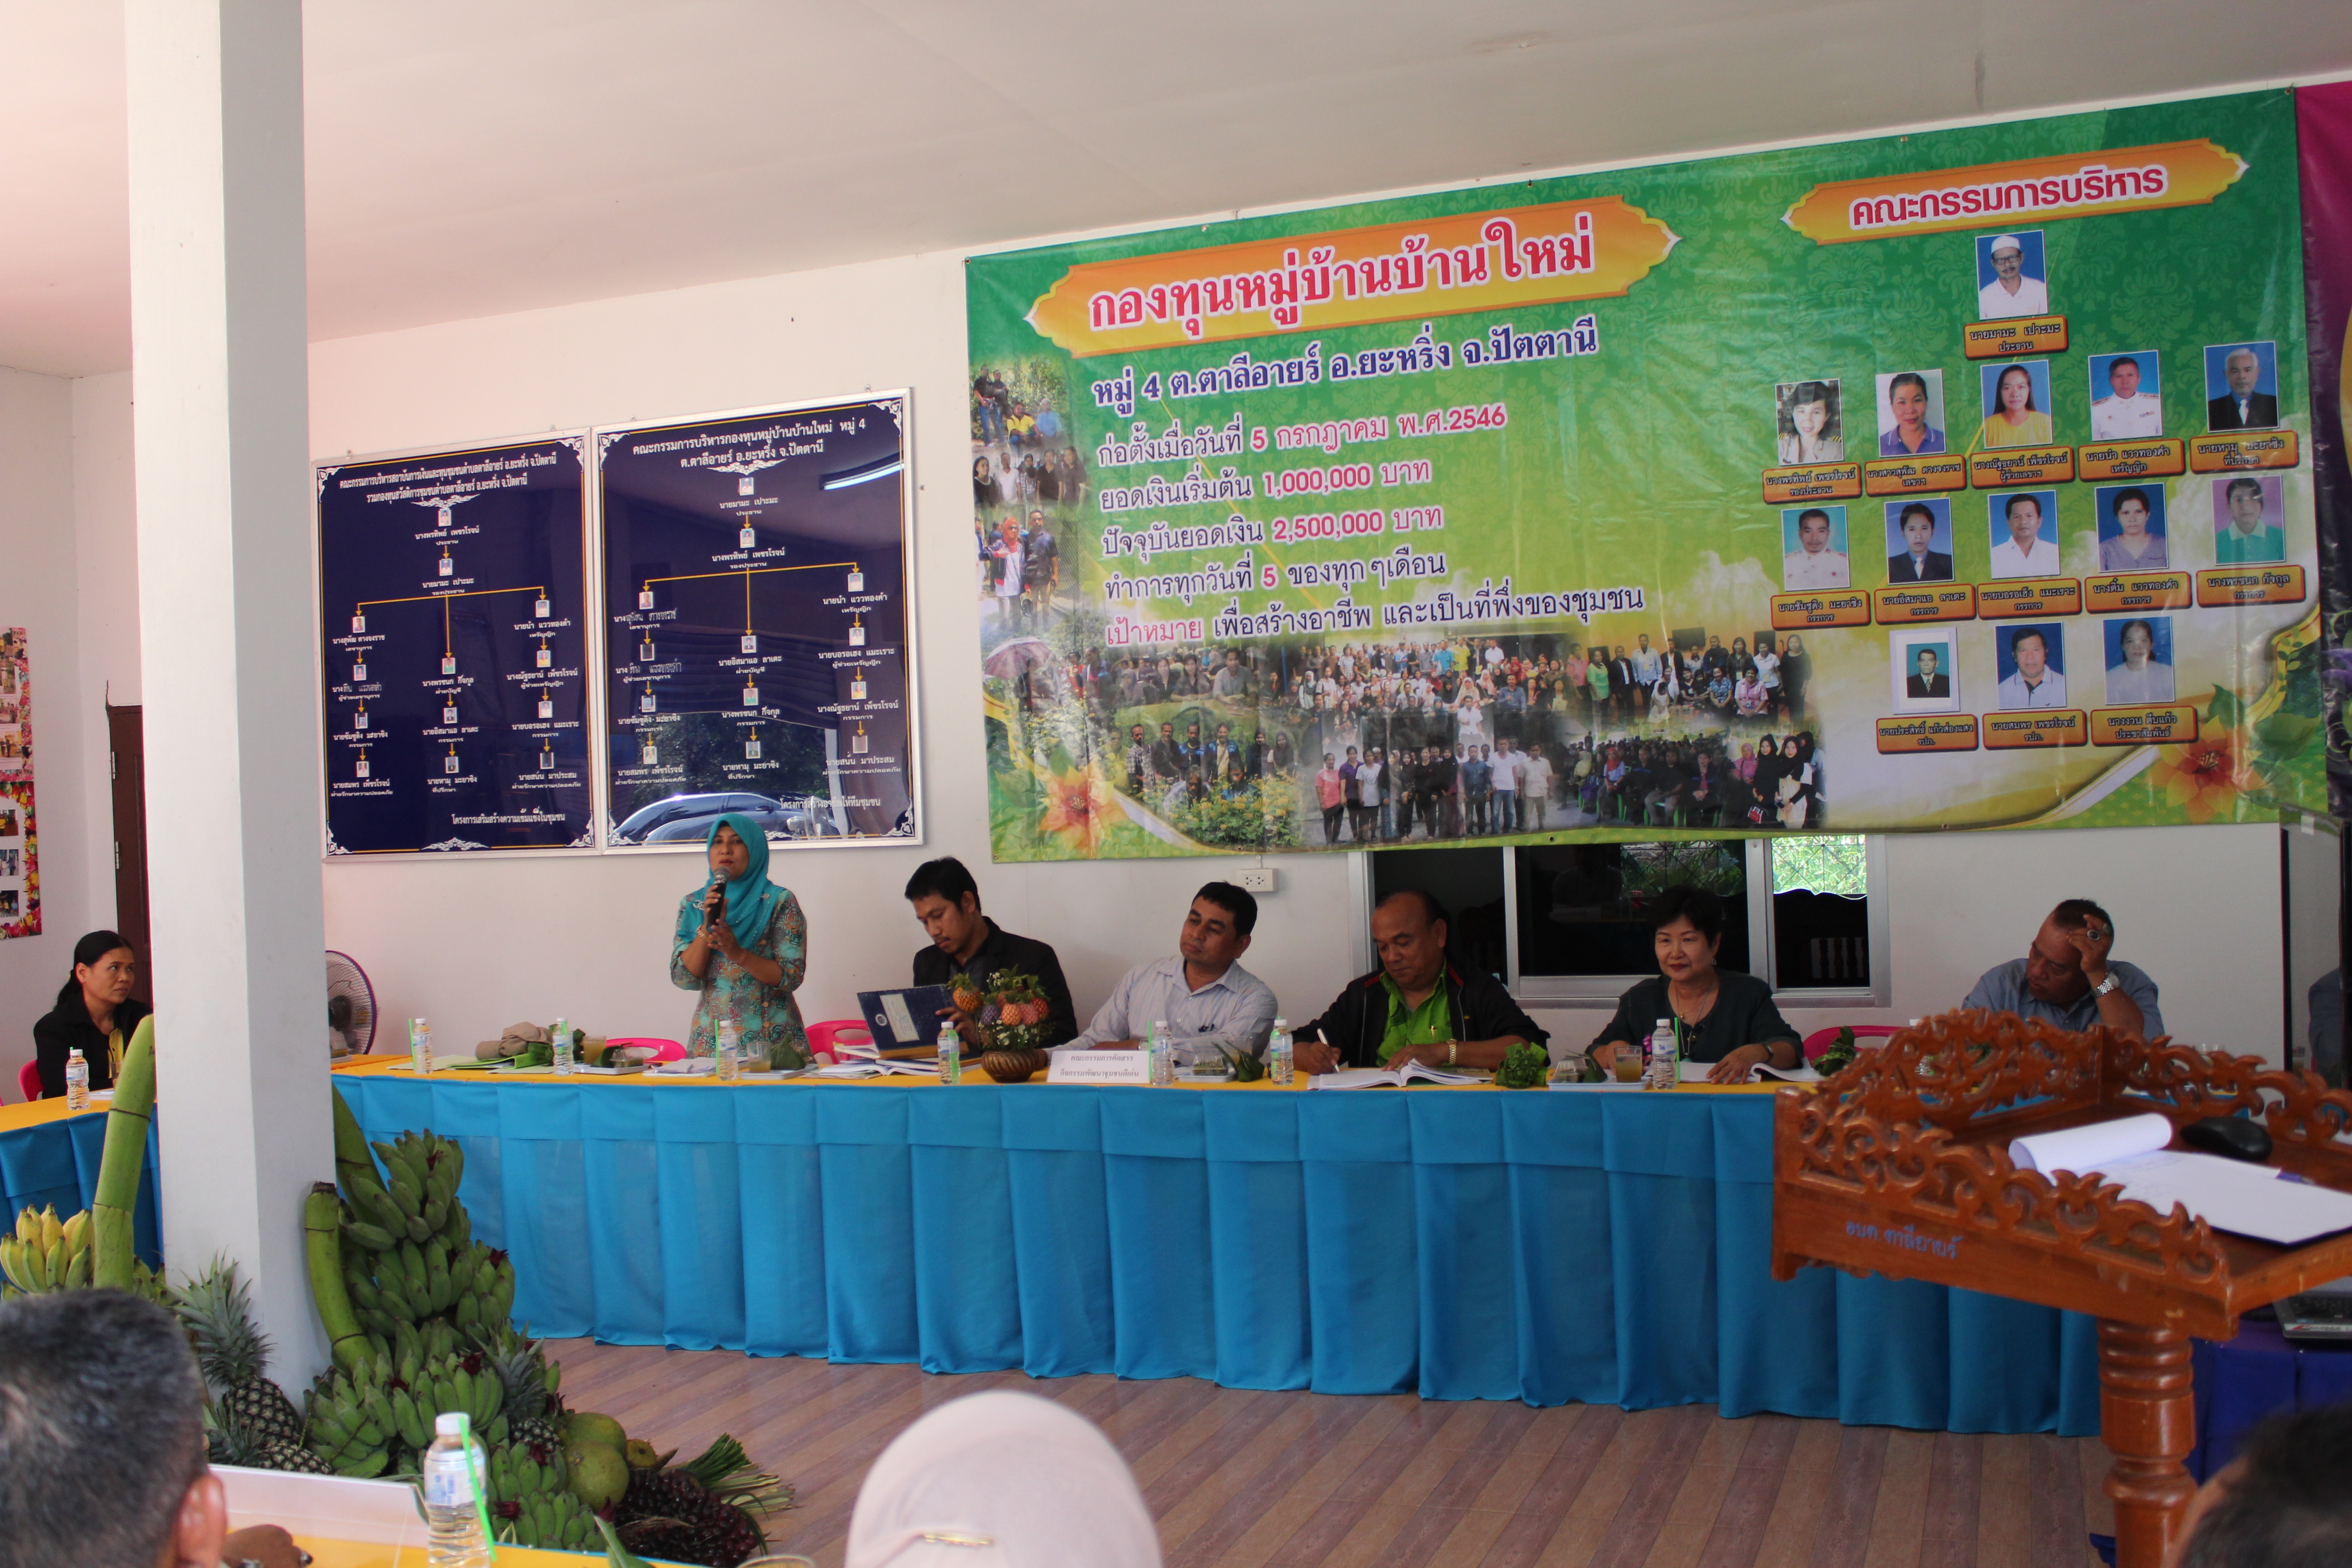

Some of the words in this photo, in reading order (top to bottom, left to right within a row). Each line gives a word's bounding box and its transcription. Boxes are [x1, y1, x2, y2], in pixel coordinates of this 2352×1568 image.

[1852, 168, 2164, 226] คณะกรรมการบริหาร
[1091, 216, 1591, 337] กองทุนหมู่บ้านบ้านใหม่
[1970, 327, 2016, 340] นายมามะ
[2024, 323, 2061, 335] เปาะมะ
[1999, 341, 2034, 352] ประธาน
[1093, 368, 1132, 415] หมู่
[1143, 374, 1160, 397] 4
[1171, 343, 1319, 396] ต.ตาลีอายร์
[1332, 324, 1451, 378] อ.ยะหริ่ง
[1464, 317, 1597, 364] จ.ปัตตานี
[633, 420, 833, 456] คณะกรรมการบริหารกองทุนหมู่บ้านบ้านใหม่
[839, 417, 855, 435] หมู่
[858, 418, 866, 429] 4
[1099, 414, 1241, 465] ก่อตั้งเมื่อวันที่
[1252, 430, 1265, 449] 5
[1277, 419, 1386, 451] กรกฎาคม
[1398, 405, 1506, 435] พ.ศ.2546
[505, 453, 529, 470] อ.ยะหริ่ง
[530, 451, 557, 467] จ.ปัตตานี
[681, 449, 732, 468] ต.ตาลีอายร์
[736, 443, 775, 463] อ.ยะหริ่ง
[779, 438, 824, 456] จ.ปัตตานี
[2086, 448, 2117, 461] นายนำ
[2122, 446, 2170, 459] แววทองคำ
[2224, 453, 2259, 466] ที่ปรึกษา
[1974, 455, 2025, 470] นางณัฐธยาน์
[2027, 452, 2068, 466] เพ็ชรโรจน์
[2111, 462, 2147, 475] เหรัญญิก
[476, 474, 500, 491] อ.ยะหริ่ง
[501, 472, 528, 488] จ.ปัตตานี
[1766, 470, 1812, 485] นางพรทิพย์
[1815, 467, 1856, 481] เพชรโรจน์
[1101, 464, 1252, 510] ยอดเงินเริ่มต้น
[1264, 466, 1371, 497] 1,000,000
[1382, 461, 1429, 484] บาท
[1789, 485, 1832, 495] รองประธาน
[720, 500, 750, 509] นายมามะ
[754, 497, 778, 505] เปาะมะ
[415, 528, 447, 539] นางพรทิพย์
[1102, 515, 1263, 562] ปัจจุบันยอดเงิน
[1273, 511, 1383, 542] 2,500,000
[1393, 507, 1442, 530] บาท
[712, 550, 748, 561] นางพรทิพย์
[1105, 552, 1252, 604] ทำการทุกวันที่
[1263, 567, 1276, 587] 5
[2132, 579, 2178, 592] แววทองคำ
[2208, 574, 2259, 588] นางพรชนก
[1882, 593, 1933, 605] นายอิสมาแอ
[1106, 616, 1203, 645] เป้าหมาย
[1214, 598, 1372, 637] เพื่อสร้างอาชีพ
[1384, 578, 1644, 625] และเป็นที่พึ่งของชุมชน
[736, 666, 765, 674] ฝ่ายบัญชี
[832, 659, 881, 669] ผู้ช่วยเหรัญญิก
[1879, 721, 1926, 736] นายประสิทธิ์
[1928, 722, 1973, 735] แก้วส่องแสง
[1991, 720, 2031, 731] นายสมพร
[2034, 715, 2076, 728] เพชรโรจน์
[2024, 731, 2043, 742] รปภ.
[2115, 726, 2171, 739] ประชาสัมพันธ์
[1917, 737, 1936, 746] รปภ.
[861, 756, 894, 764] มาประสม
